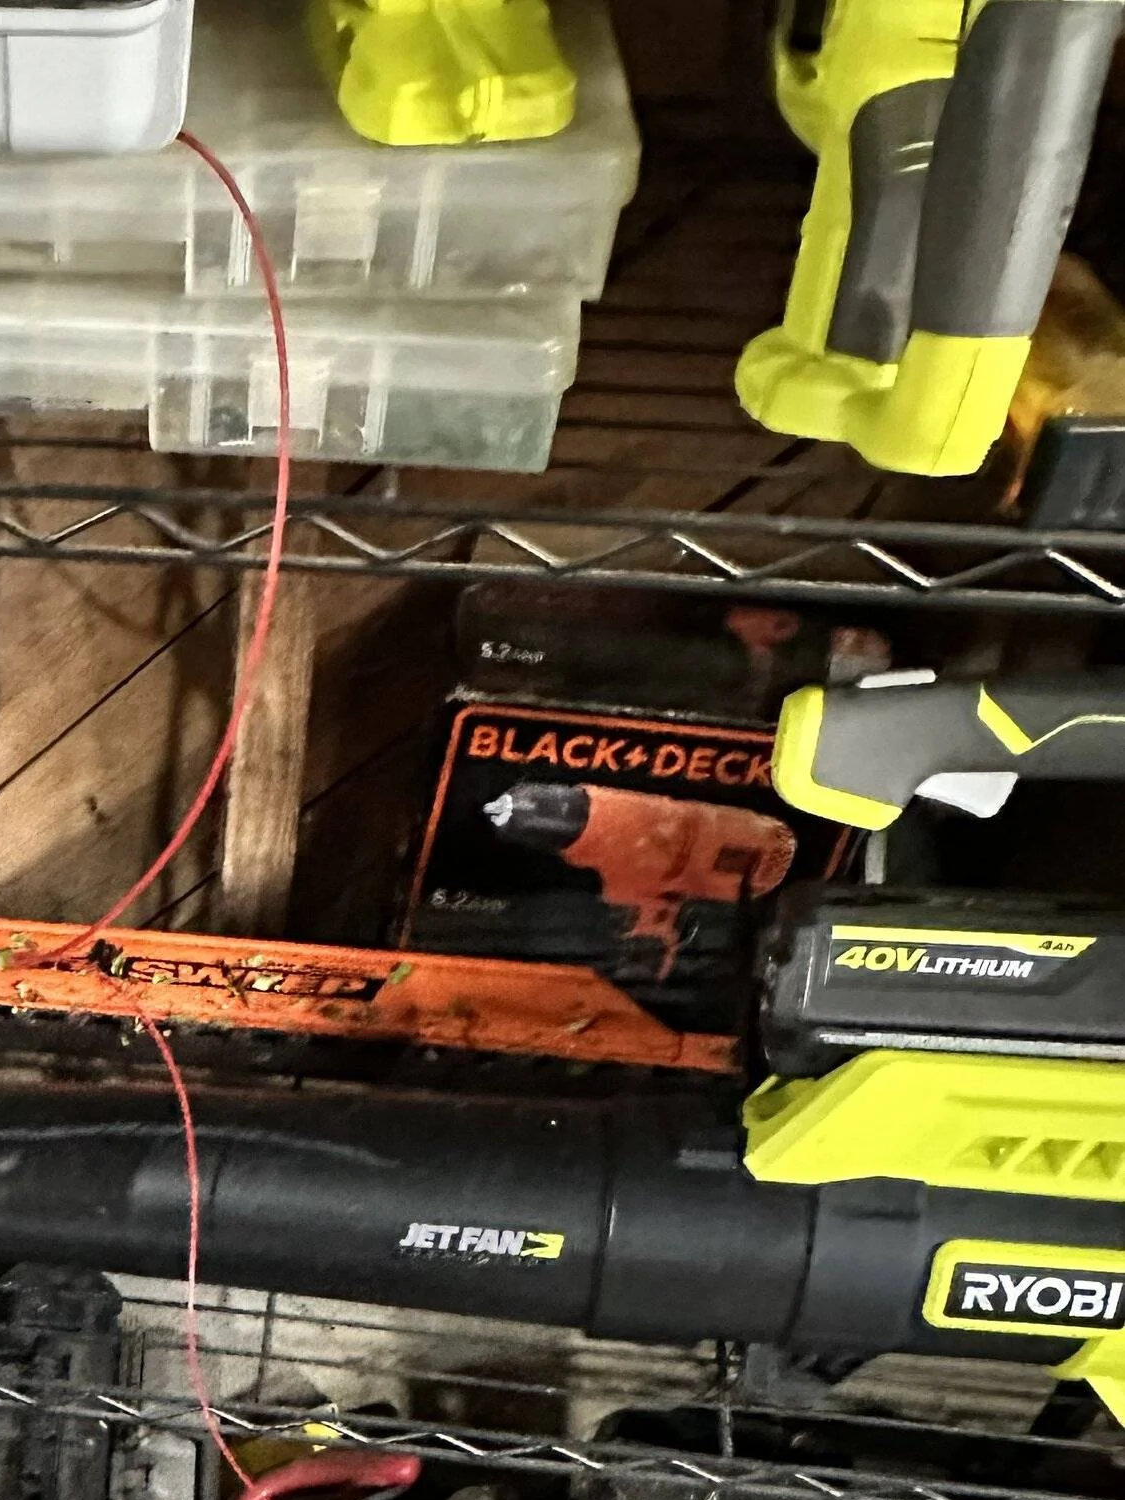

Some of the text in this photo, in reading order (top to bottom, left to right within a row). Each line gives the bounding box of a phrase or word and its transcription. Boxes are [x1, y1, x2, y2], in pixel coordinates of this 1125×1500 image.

[398, 1222, 526, 1256] JET FAN
[961, 1271, 1124, 1320] RYOBI
